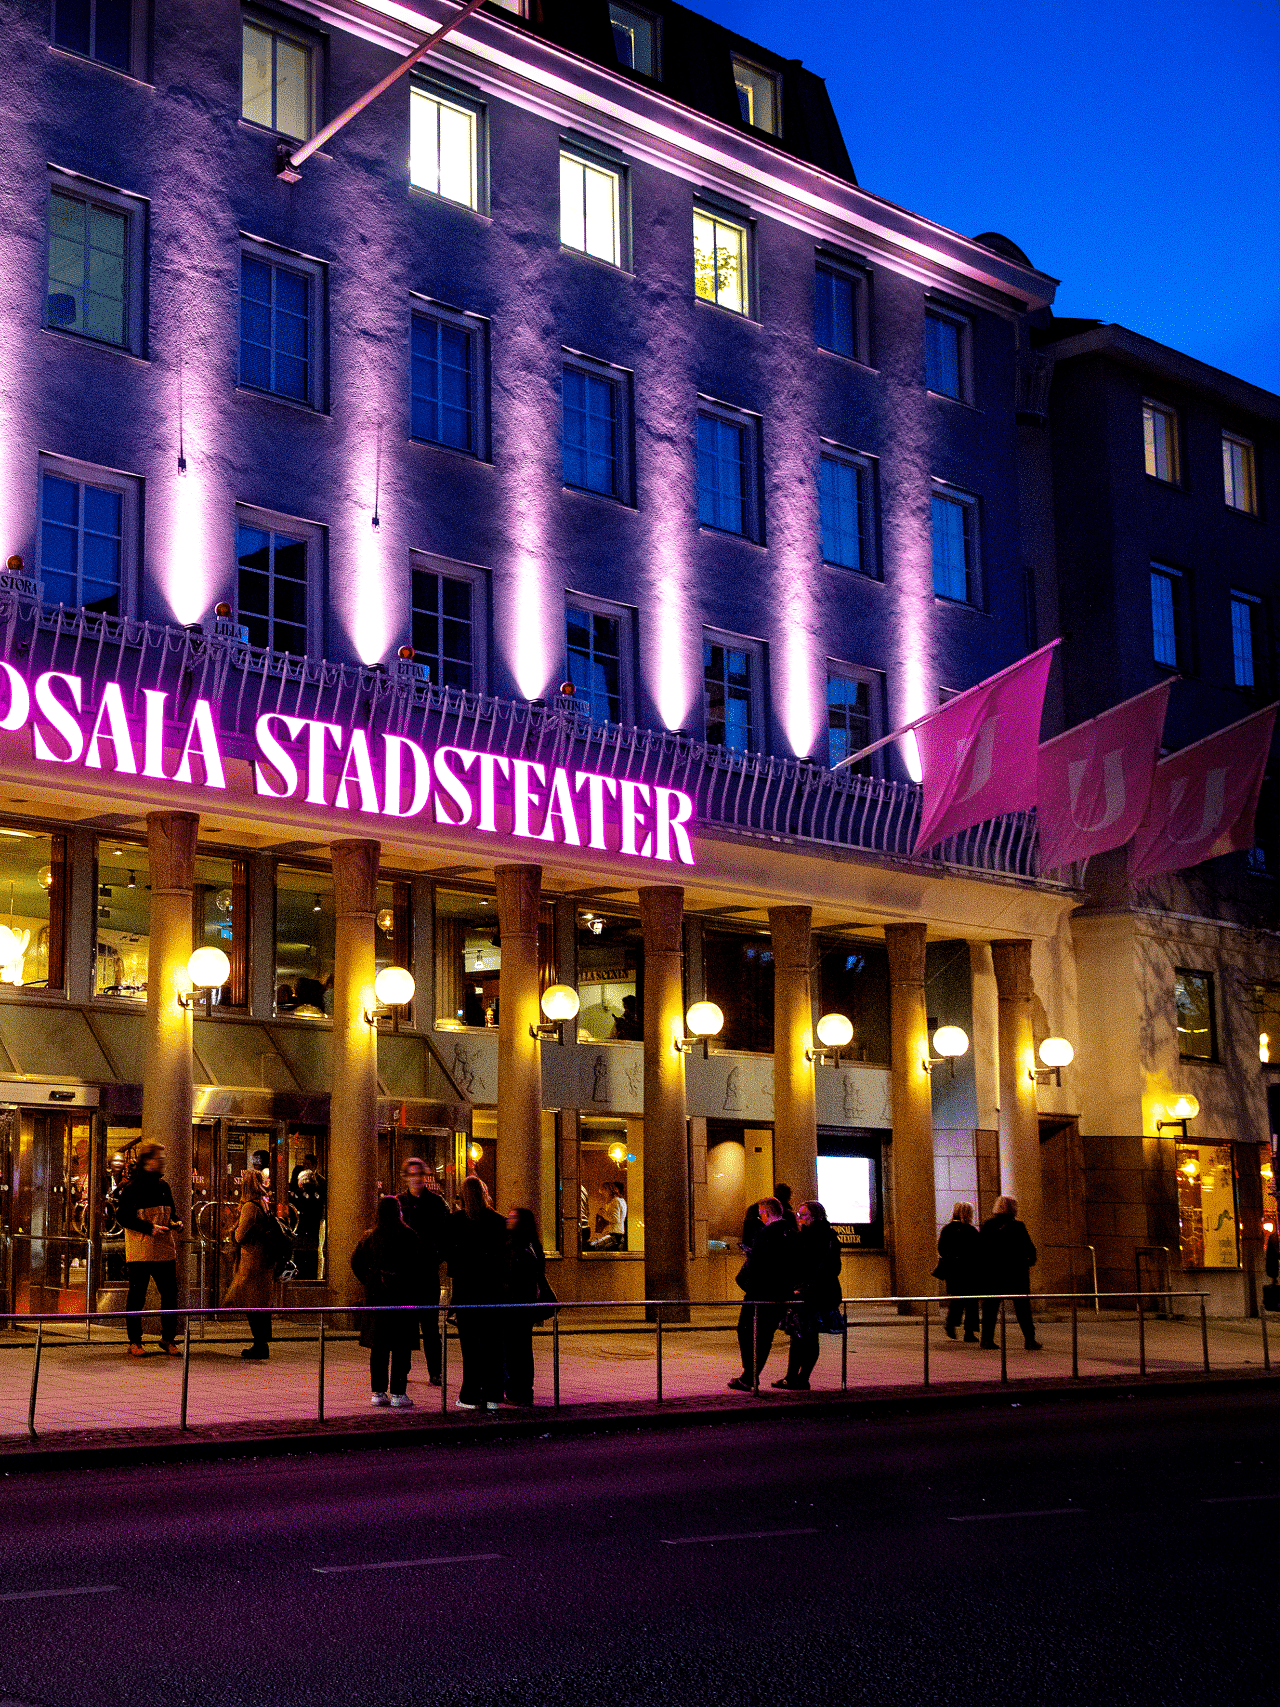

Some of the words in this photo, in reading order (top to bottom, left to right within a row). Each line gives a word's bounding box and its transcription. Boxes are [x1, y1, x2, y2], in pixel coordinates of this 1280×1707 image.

[0, 575, 38, 596] STORA
[214, 621, 242, 639] LILLA
[254, 712, 697, 867] STADSTEATER
[1067, 749, 1127, 833] U
